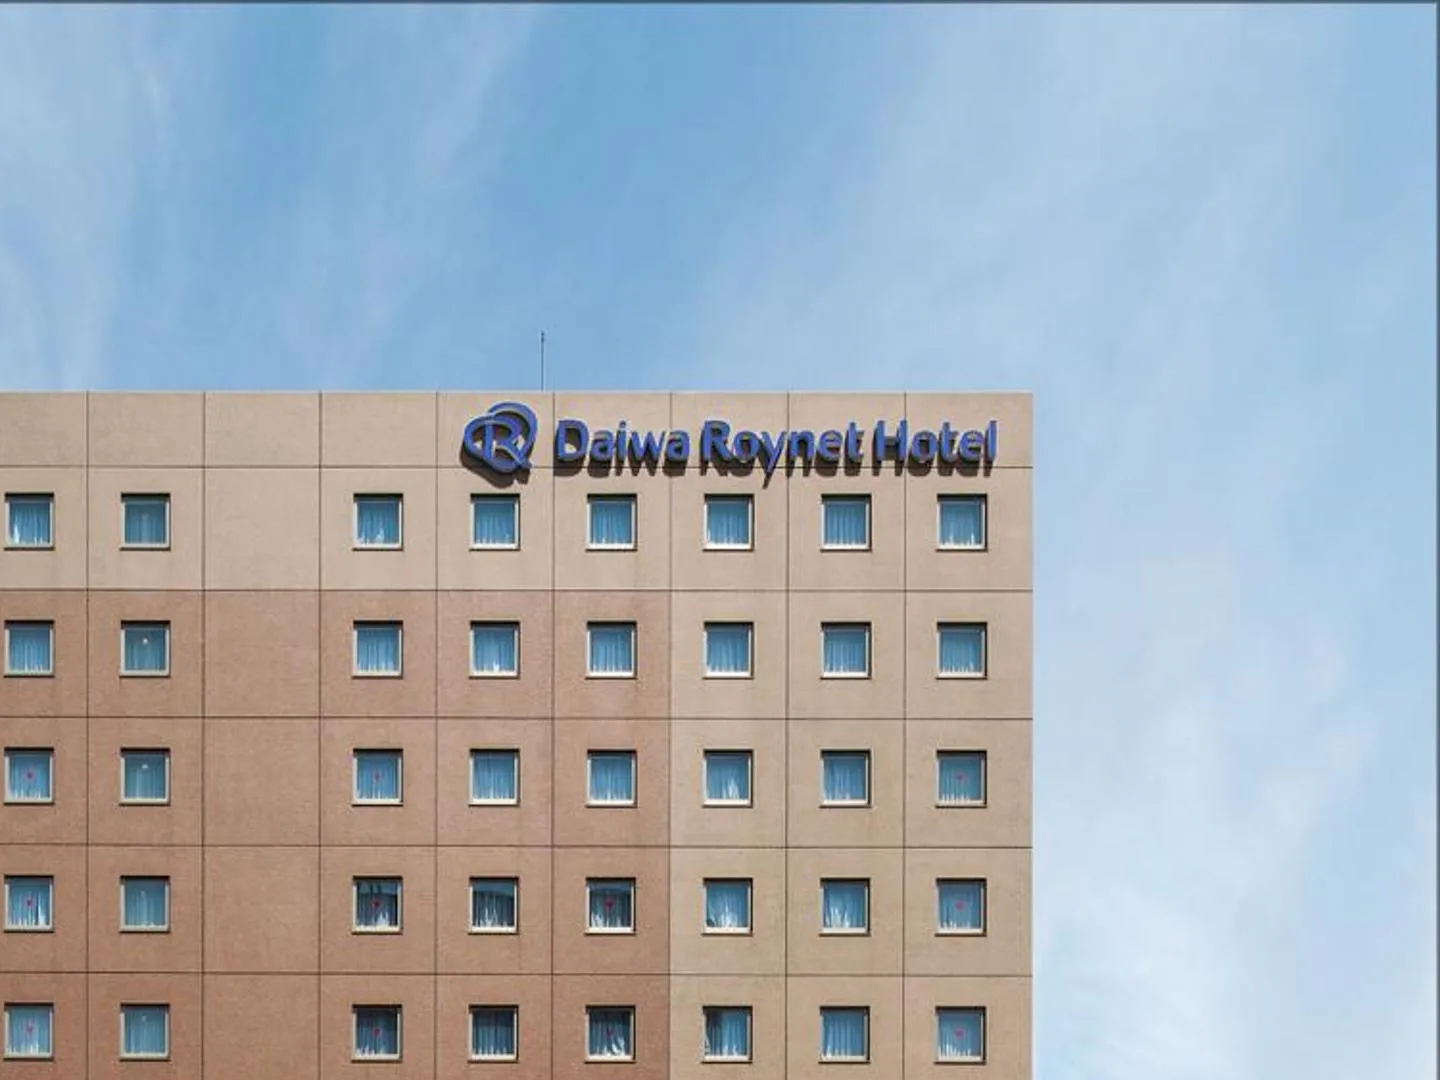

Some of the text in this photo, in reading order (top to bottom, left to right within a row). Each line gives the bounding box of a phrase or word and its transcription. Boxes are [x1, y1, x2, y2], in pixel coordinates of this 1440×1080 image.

[556, 419, 691, 463] Daiwa
[700, 419, 864, 474] Roynet
[876, 419, 998, 464] Hotel
